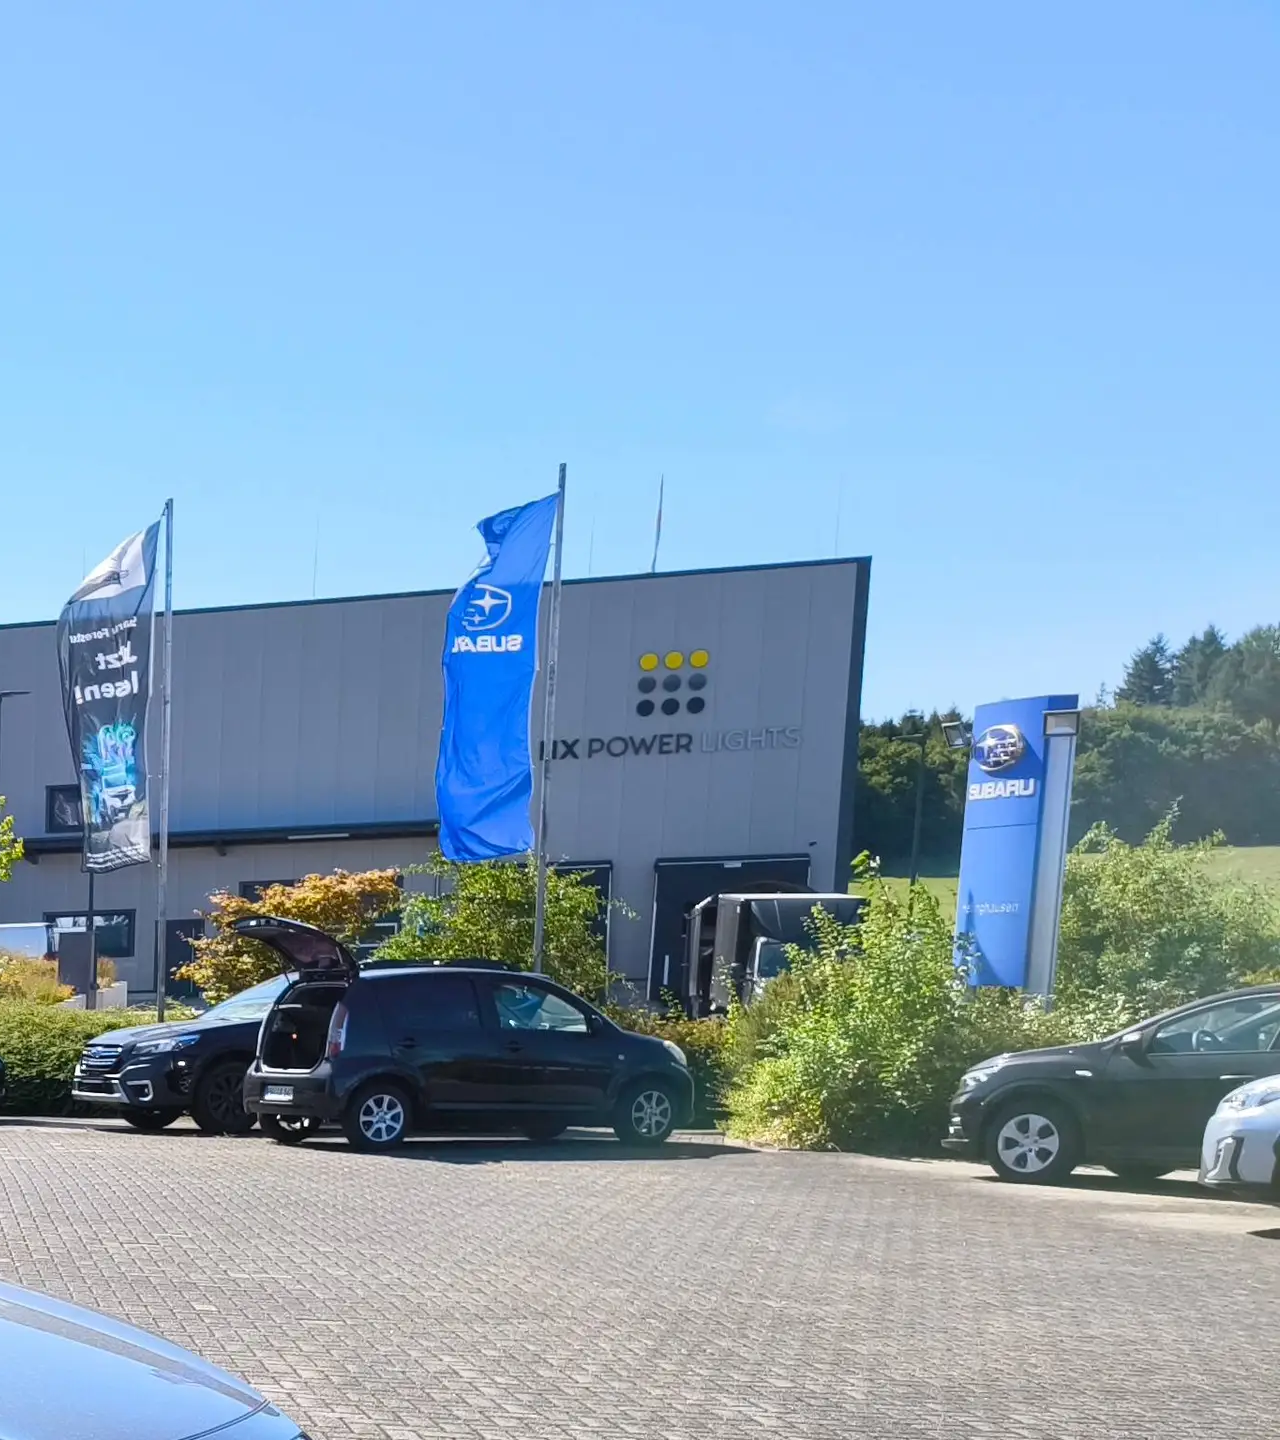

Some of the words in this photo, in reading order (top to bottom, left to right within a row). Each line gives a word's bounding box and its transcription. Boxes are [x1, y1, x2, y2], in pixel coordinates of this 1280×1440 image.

[587, 733, 693, 759] POWER
[701, 726, 801, 753] LIGHTS
[969, 778, 1035, 800] SUBARU
